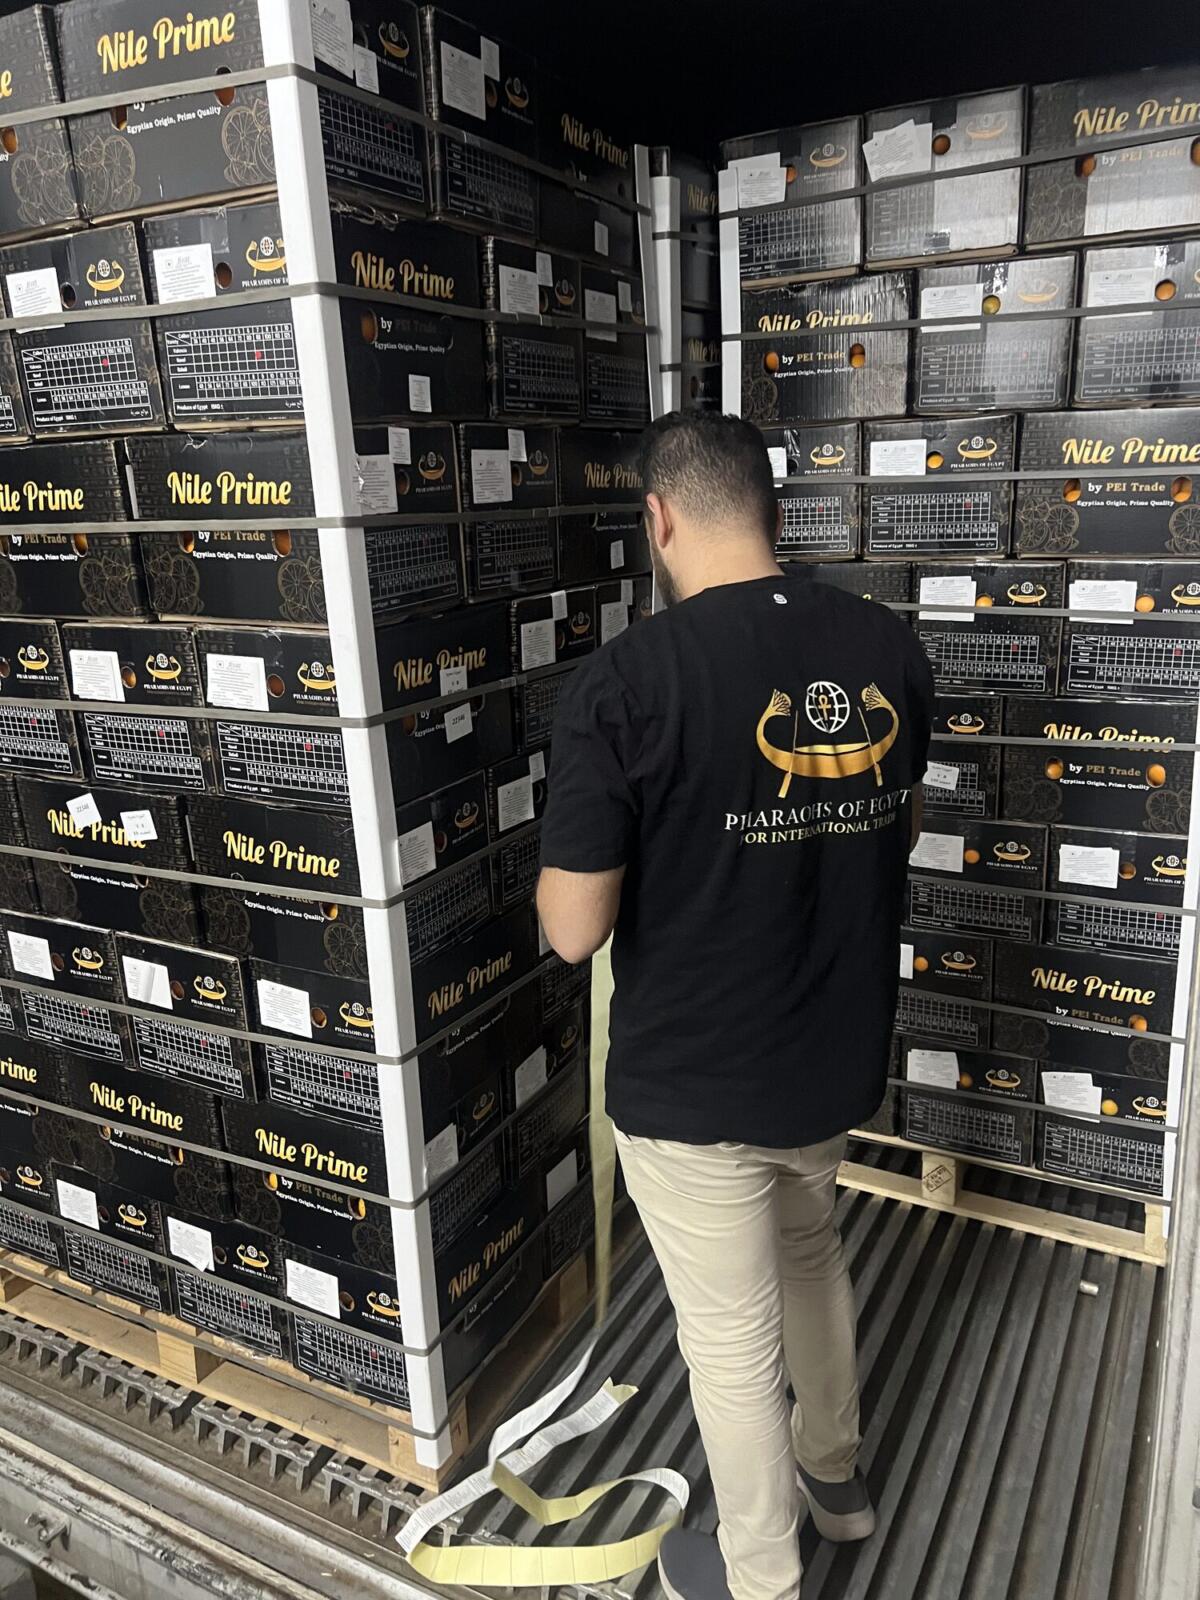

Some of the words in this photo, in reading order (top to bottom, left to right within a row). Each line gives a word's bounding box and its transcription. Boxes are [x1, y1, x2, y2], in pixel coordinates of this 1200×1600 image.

[97, 30, 148, 74] Nile
[152, 12, 236, 59] Prime
[127, 121, 154, 134] Egyptian
[177, 112, 196, 123] Prime
[197, 105, 221, 119] Quality
[1073, 106, 1129, 138] Nile
[1136, 96, 1200, 129] Prim
[561, 113, 590, 151] Nile
[592, 128, 629, 169] Prime
[351, 251, 395, 291] Nile
[399, 259, 454, 299] Prime
[381, 316, 393, 333] by
[782, 355, 794, 365] by
[797, 353, 814, 363] PEI
[816, 350, 846, 361] Trade
[1062, 438, 1115, 465] Nile
[1122, 437, 1200, 464] Prime
[167, 471, 212, 505] Nile
[216, 471, 292, 505] Prime
[584, 462, 611, 489] Nile
[613, 463, 643, 489] Prim
[1087, 482, 1102, 494] by
[1106, 483, 1127, 492] PEI
[1131, 482, 1166, 492] Trade
[0, 483, 21, 512] ile
[23, 480, 85, 512] Prime
[1076, 499, 1105, 507] Egyptian
[1150, 499, 1175, 507] Quality
[198, 530, 210, 542] by
[193, 550, 216, 560] Egyptian
[238, 551, 255, 560] Prime
[256, 552, 278, 562] Quality
[393, 658, 433, 692] Nile
[436, 646, 487, 672] Prime
[1069, 763, 1082, 773] by
[1086, 765, 1105, 774] PEI
[1108, 766, 1142, 777] Trade
[1127, 783, 1151, 791] Quality
[724, 801, 832, 831] PHARAOHS
[838, 800, 865, 819] OF
[223, 830, 265, 866] Nile
[269, 841, 340, 878] Prime
[244, 899, 266, 910] Egyptian
[285, 909, 303, 918] Prime
[303, 912, 325, 923] Quality
[427, 982, 464, 1021] Nile
[467, 951, 512, 995] Prime
[1031, 967, 1078, 993] Nile
[1083, 975, 1156, 1005] Prime
[1055, 1005, 1068, 1016] by
[1071, 1008, 1089, 1020] PEI
[1093, 1011, 1124, 1025] Trade
[0, 1056, 37, 1084] rime
[90, 1082, 124, 1112] Nile
[128, 1095, 183, 1131] Prime
[255, 1128, 297, 1162] Nile
[301, 1143, 368, 1183] Prime
[281, 1176, 293, 1189] by
[448, 1260, 481, 1304] Nile
[483, 1216, 524, 1270] Prime
